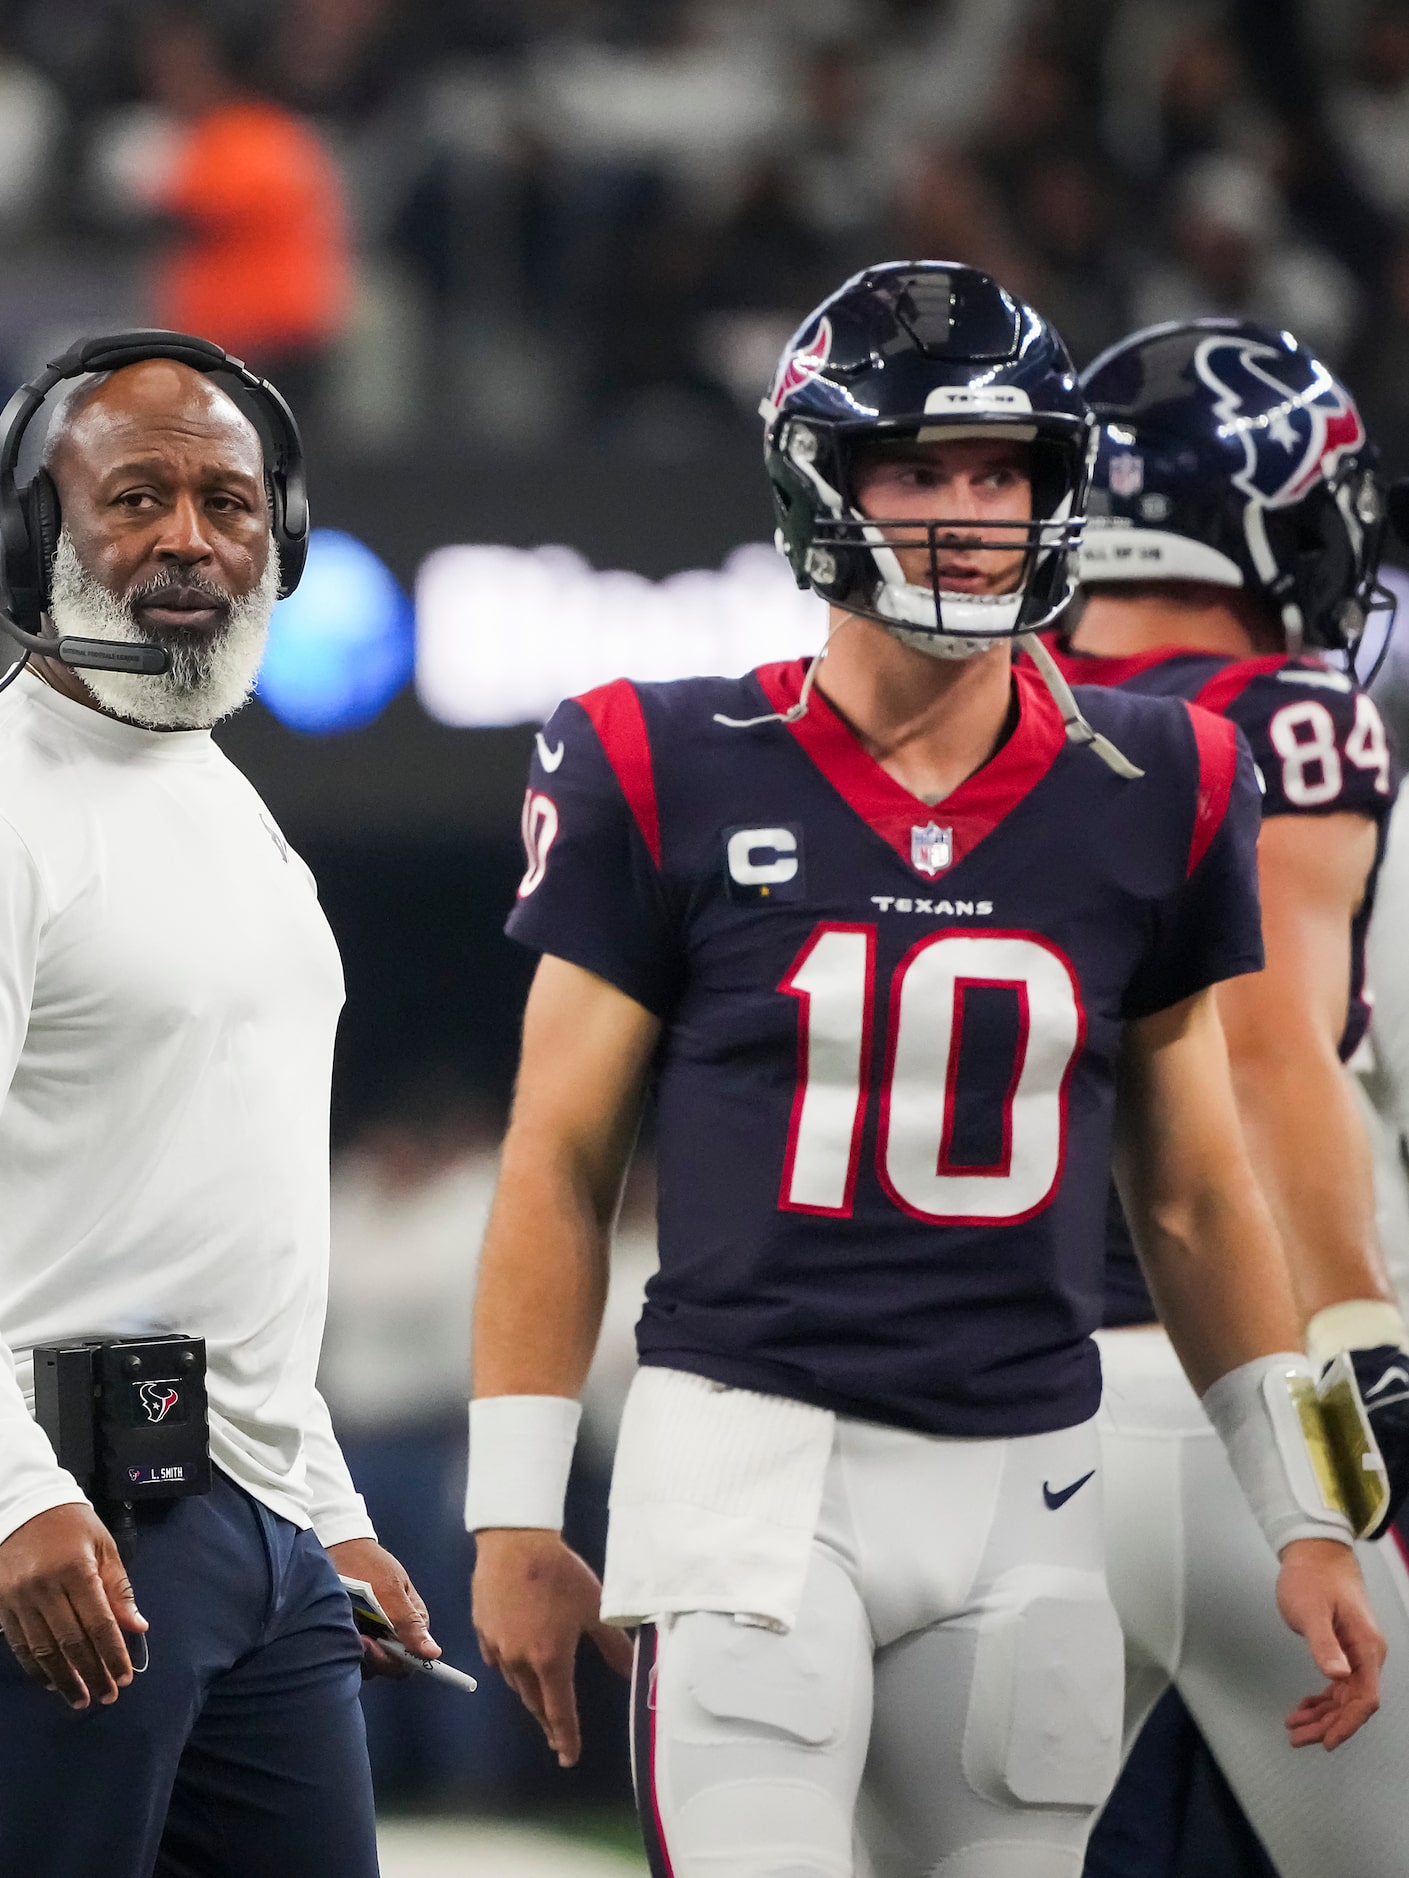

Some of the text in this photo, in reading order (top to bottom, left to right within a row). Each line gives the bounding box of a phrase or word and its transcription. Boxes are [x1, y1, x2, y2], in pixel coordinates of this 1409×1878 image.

[1268, 692, 1391, 808] 84
[727, 827, 798, 886] C
[870, 895, 994, 916] TEXANS
[776, 920, 1087, 1227] 10
[151, 1467, 183, 1480] L. SMITH
